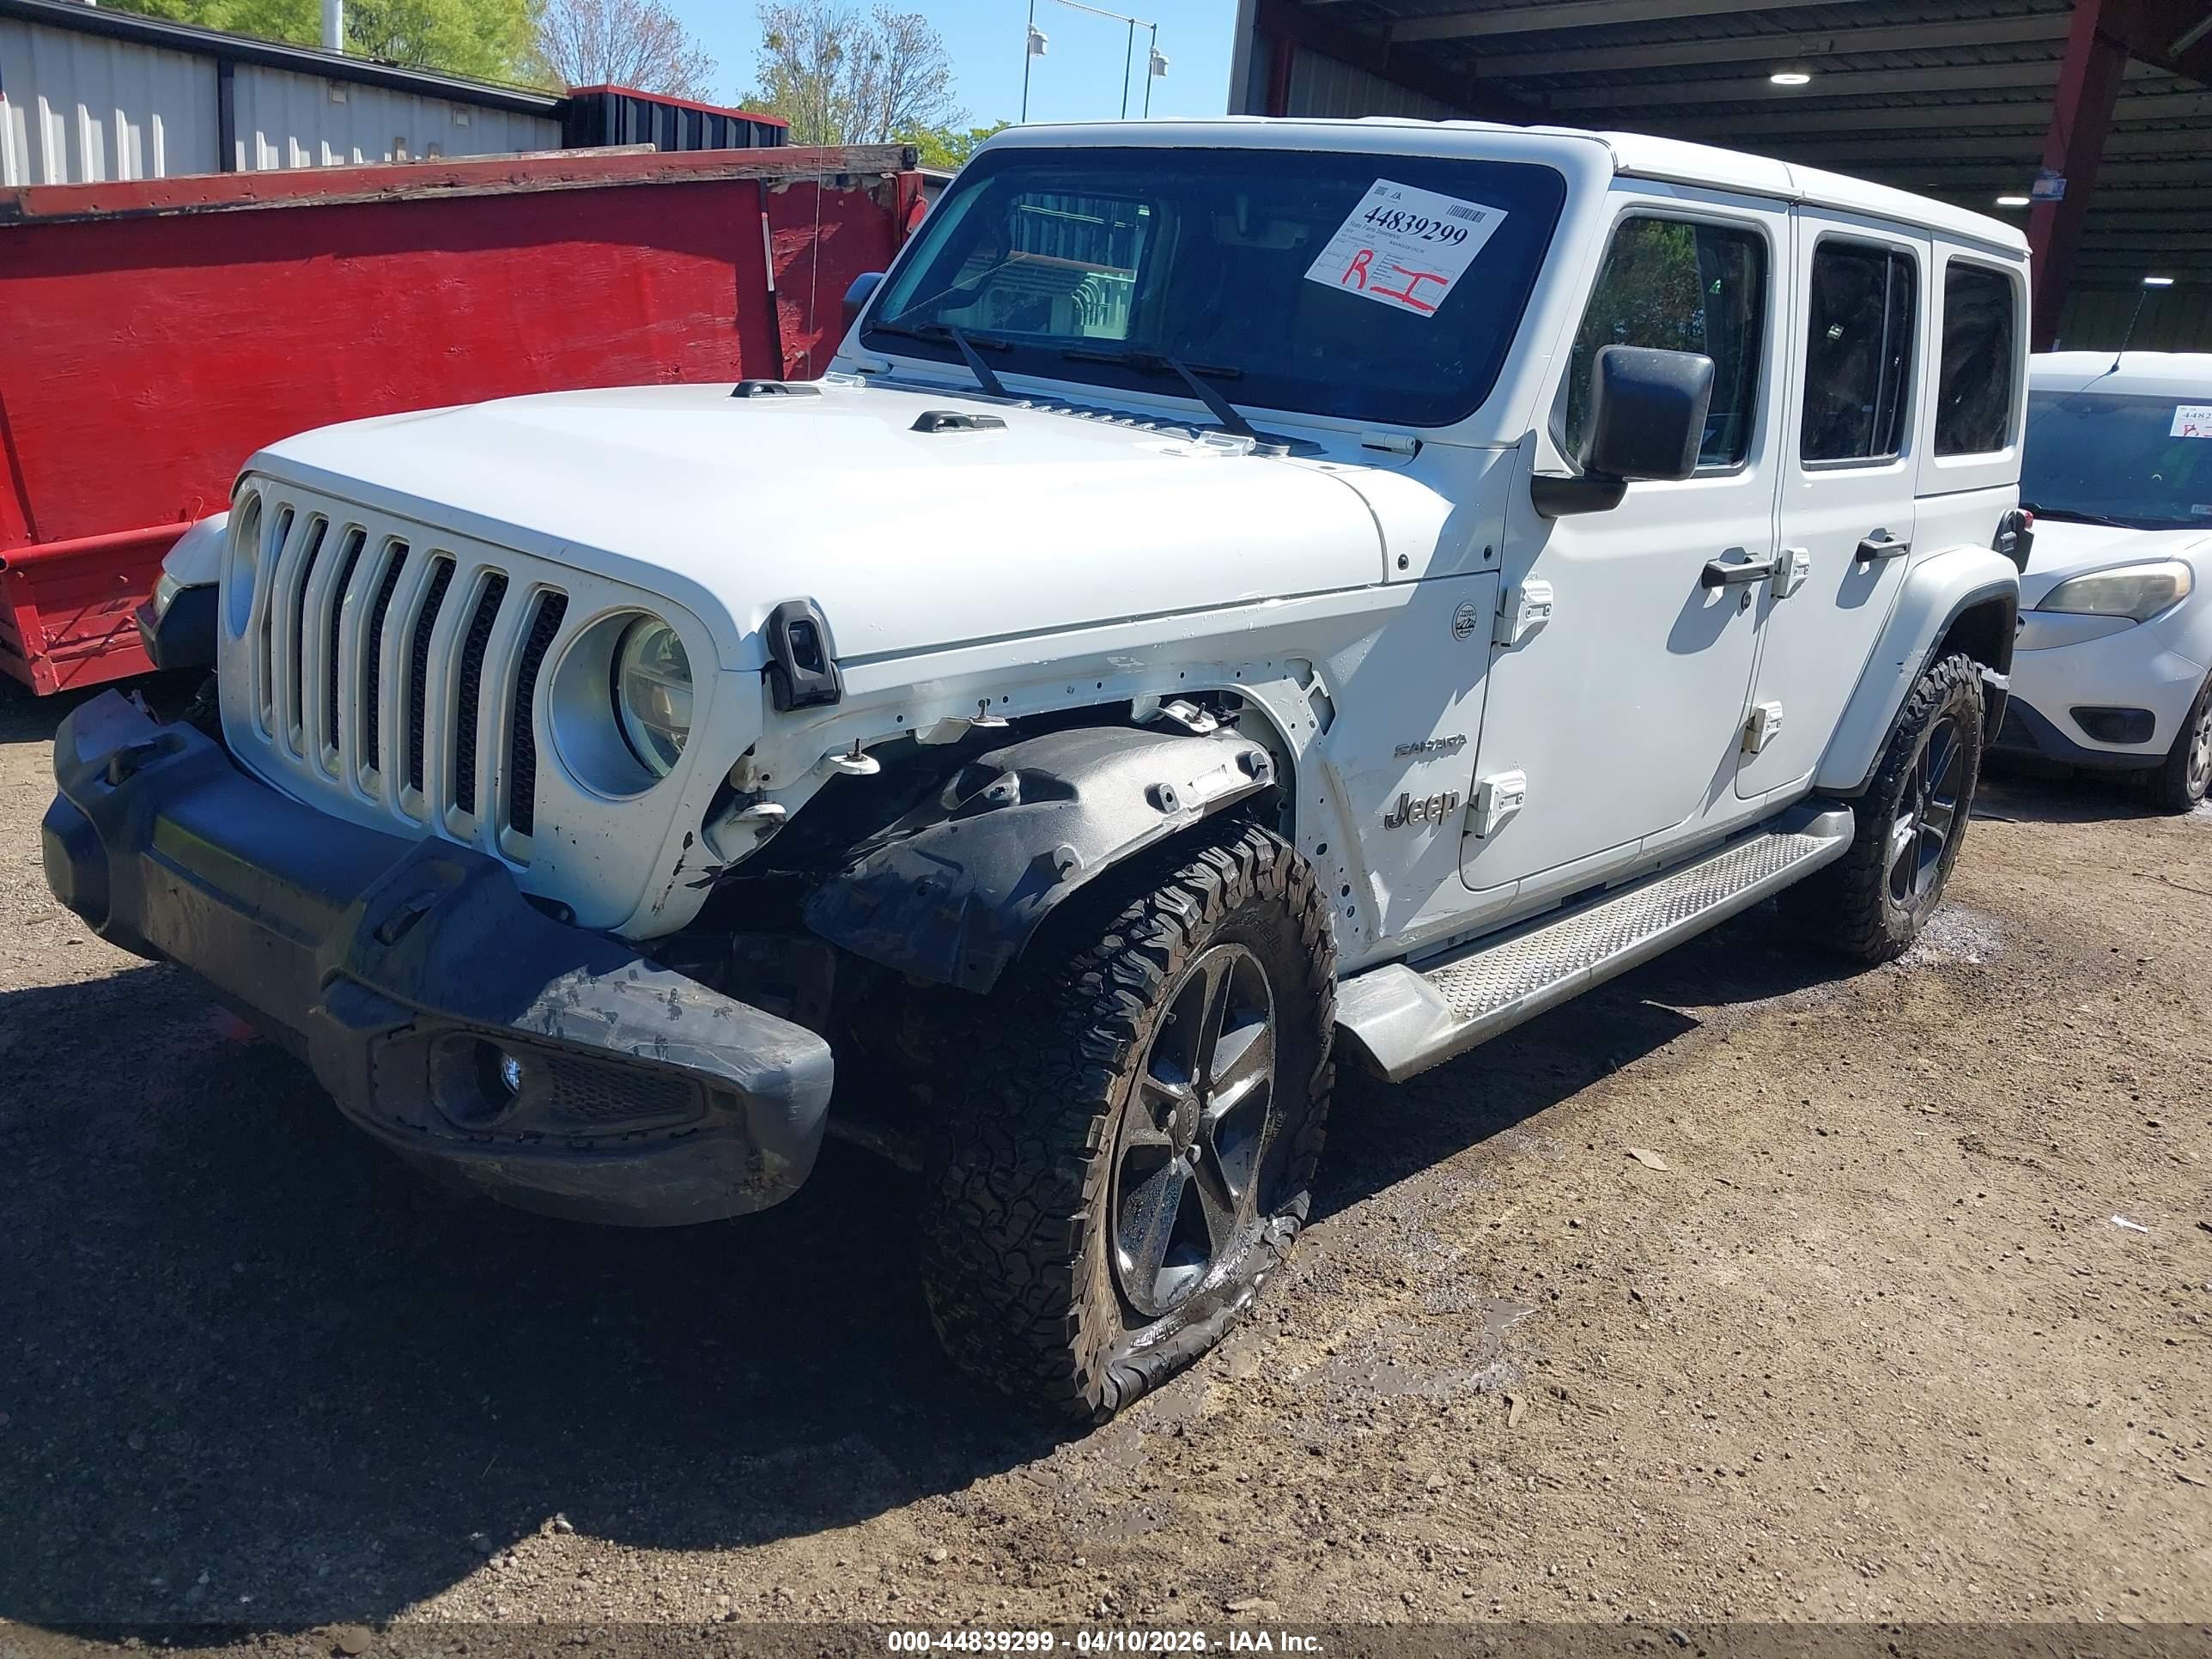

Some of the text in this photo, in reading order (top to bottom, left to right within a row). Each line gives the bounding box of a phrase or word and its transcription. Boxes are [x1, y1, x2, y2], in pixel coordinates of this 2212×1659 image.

[1361, 223, 1376, 234] Farm
[1364, 205, 1468, 246] 44839299
[1342, 249, 1375, 289] R
[1394, 733, 1468, 758] SAHARA
[1384, 788, 1460, 830] Jeep
